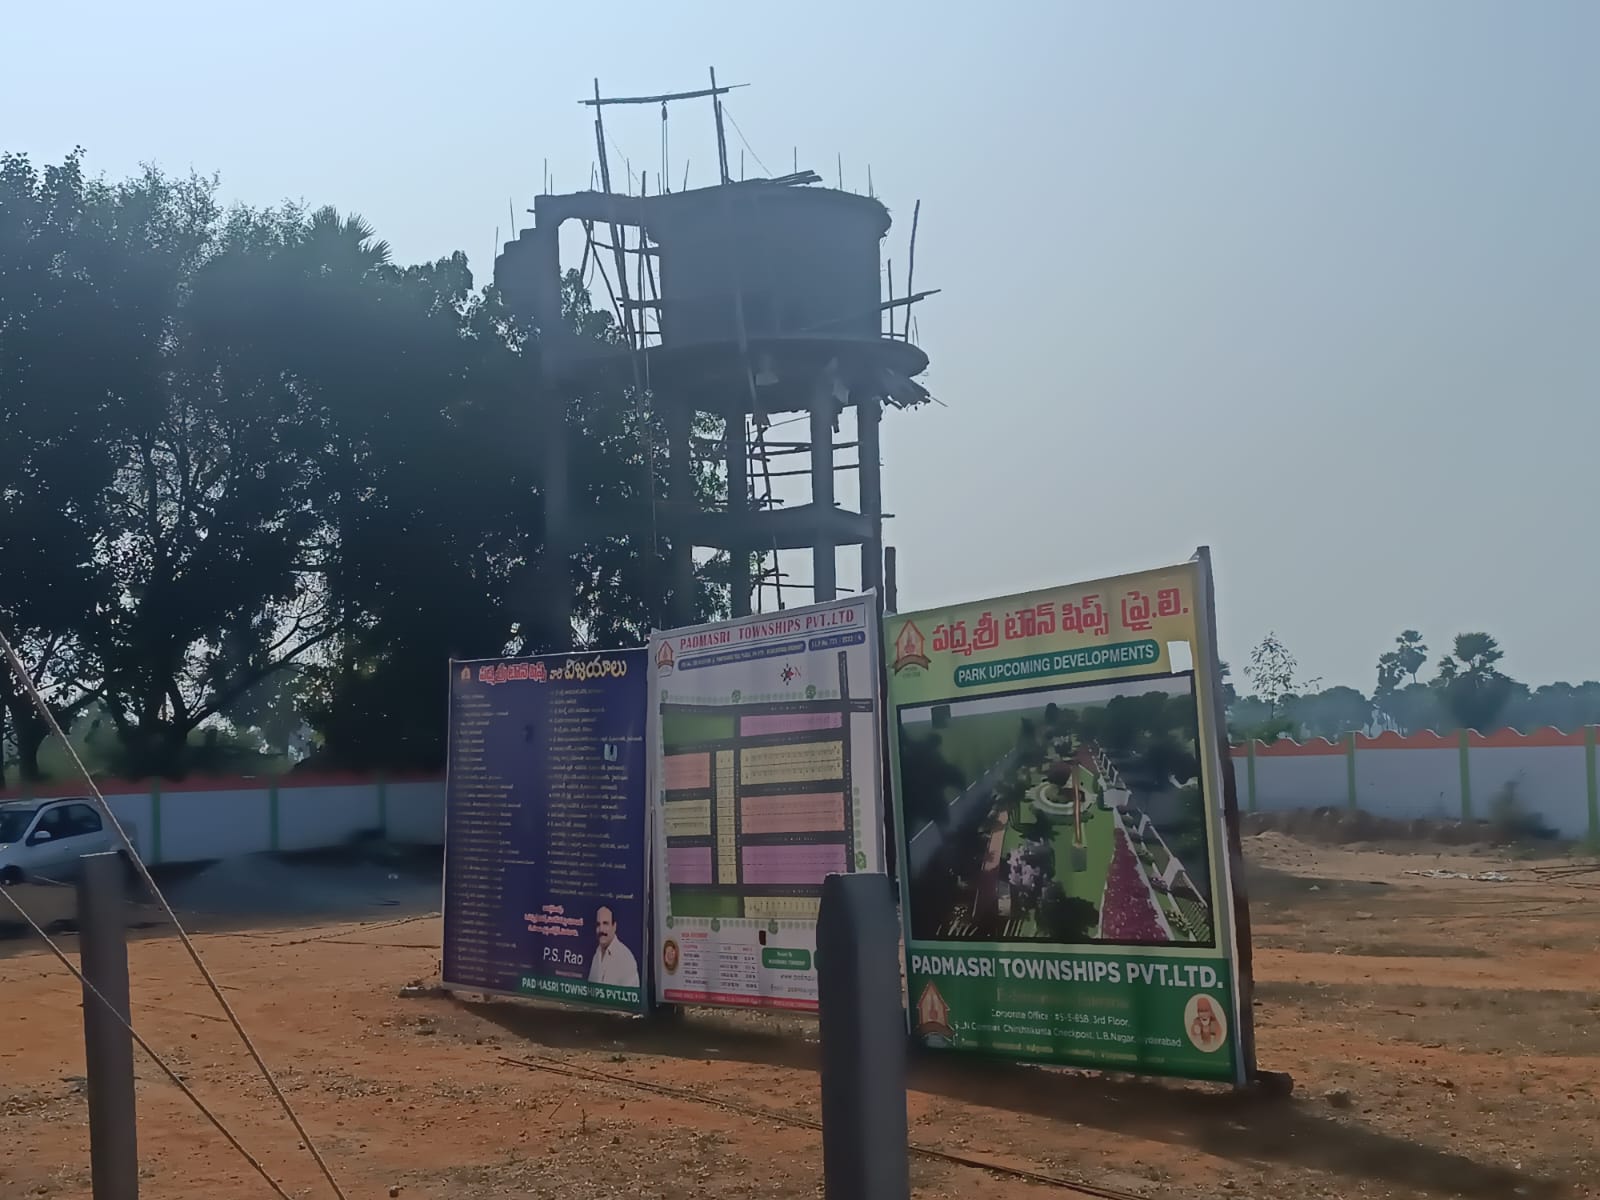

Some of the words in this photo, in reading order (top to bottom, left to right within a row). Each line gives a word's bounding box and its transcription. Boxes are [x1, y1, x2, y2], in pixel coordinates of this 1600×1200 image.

[679, 630, 731, 650] PADMASRI
[738, 617, 801, 639] TOWNSHIPS
[958, 663, 987, 683] PARK
[989, 657, 1051, 679] UPCOMING
[1053, 643, 1155, 671] DEVELOPMENTS
[543, 947, 561, 963] P.S.
[563, 949, 584, 965] Rao
[912, 954, 996, 978] PADMASRI
[998, 958, 1121, 984] TOWNSHIPS
[1127, 962, 1224, 989] PVT.LTD.
